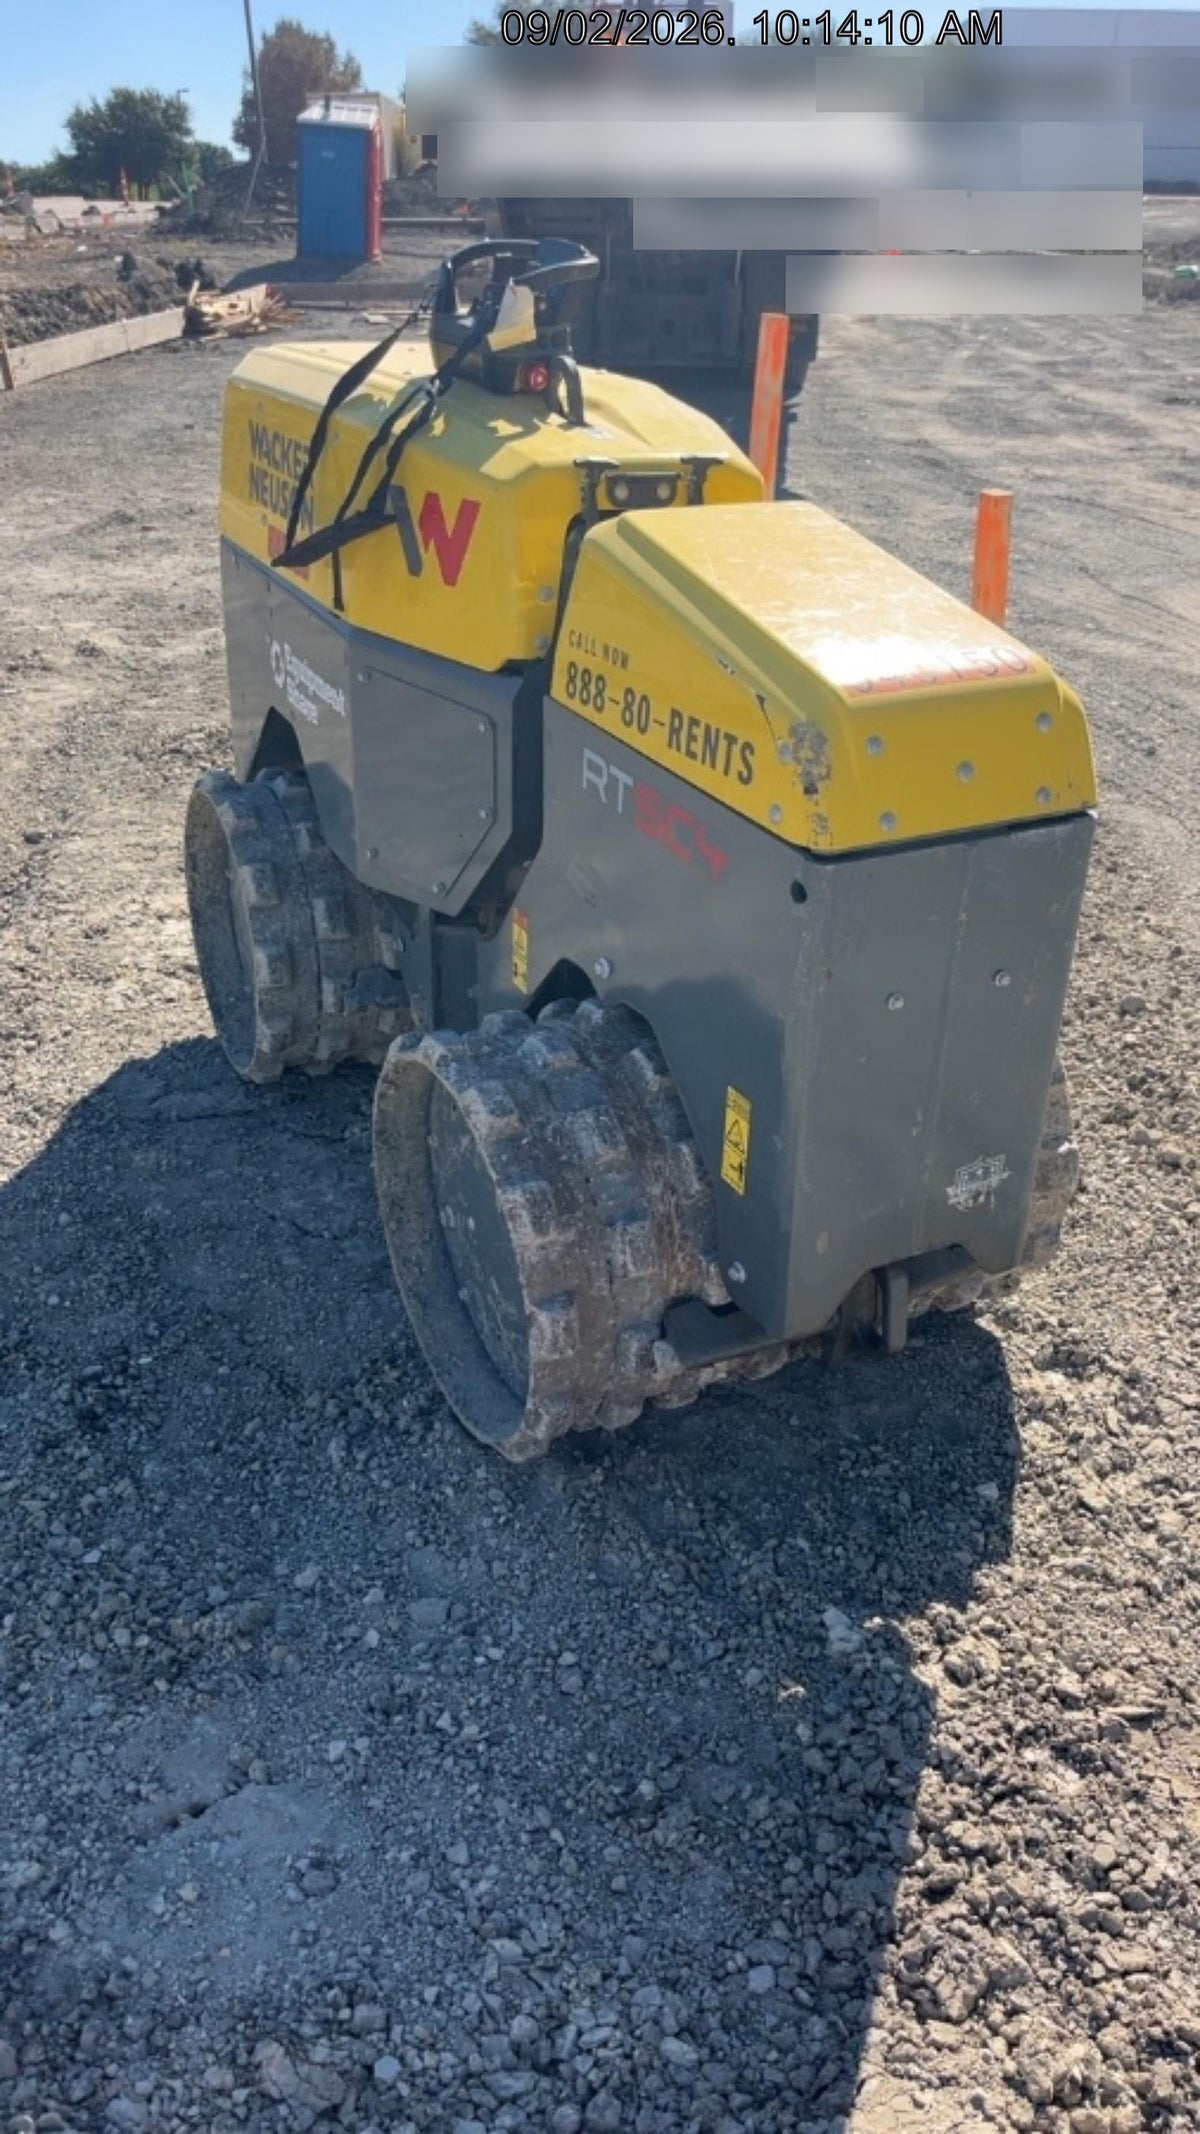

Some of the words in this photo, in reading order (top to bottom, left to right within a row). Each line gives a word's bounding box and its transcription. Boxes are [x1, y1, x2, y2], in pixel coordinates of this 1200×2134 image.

[248, 462, 314, 535] NEUSN
[568, 630, 598, 658] CALL
[603, 643, 631, 671] NOW
[566, 661, 756, 786] 888-80-RENTS
